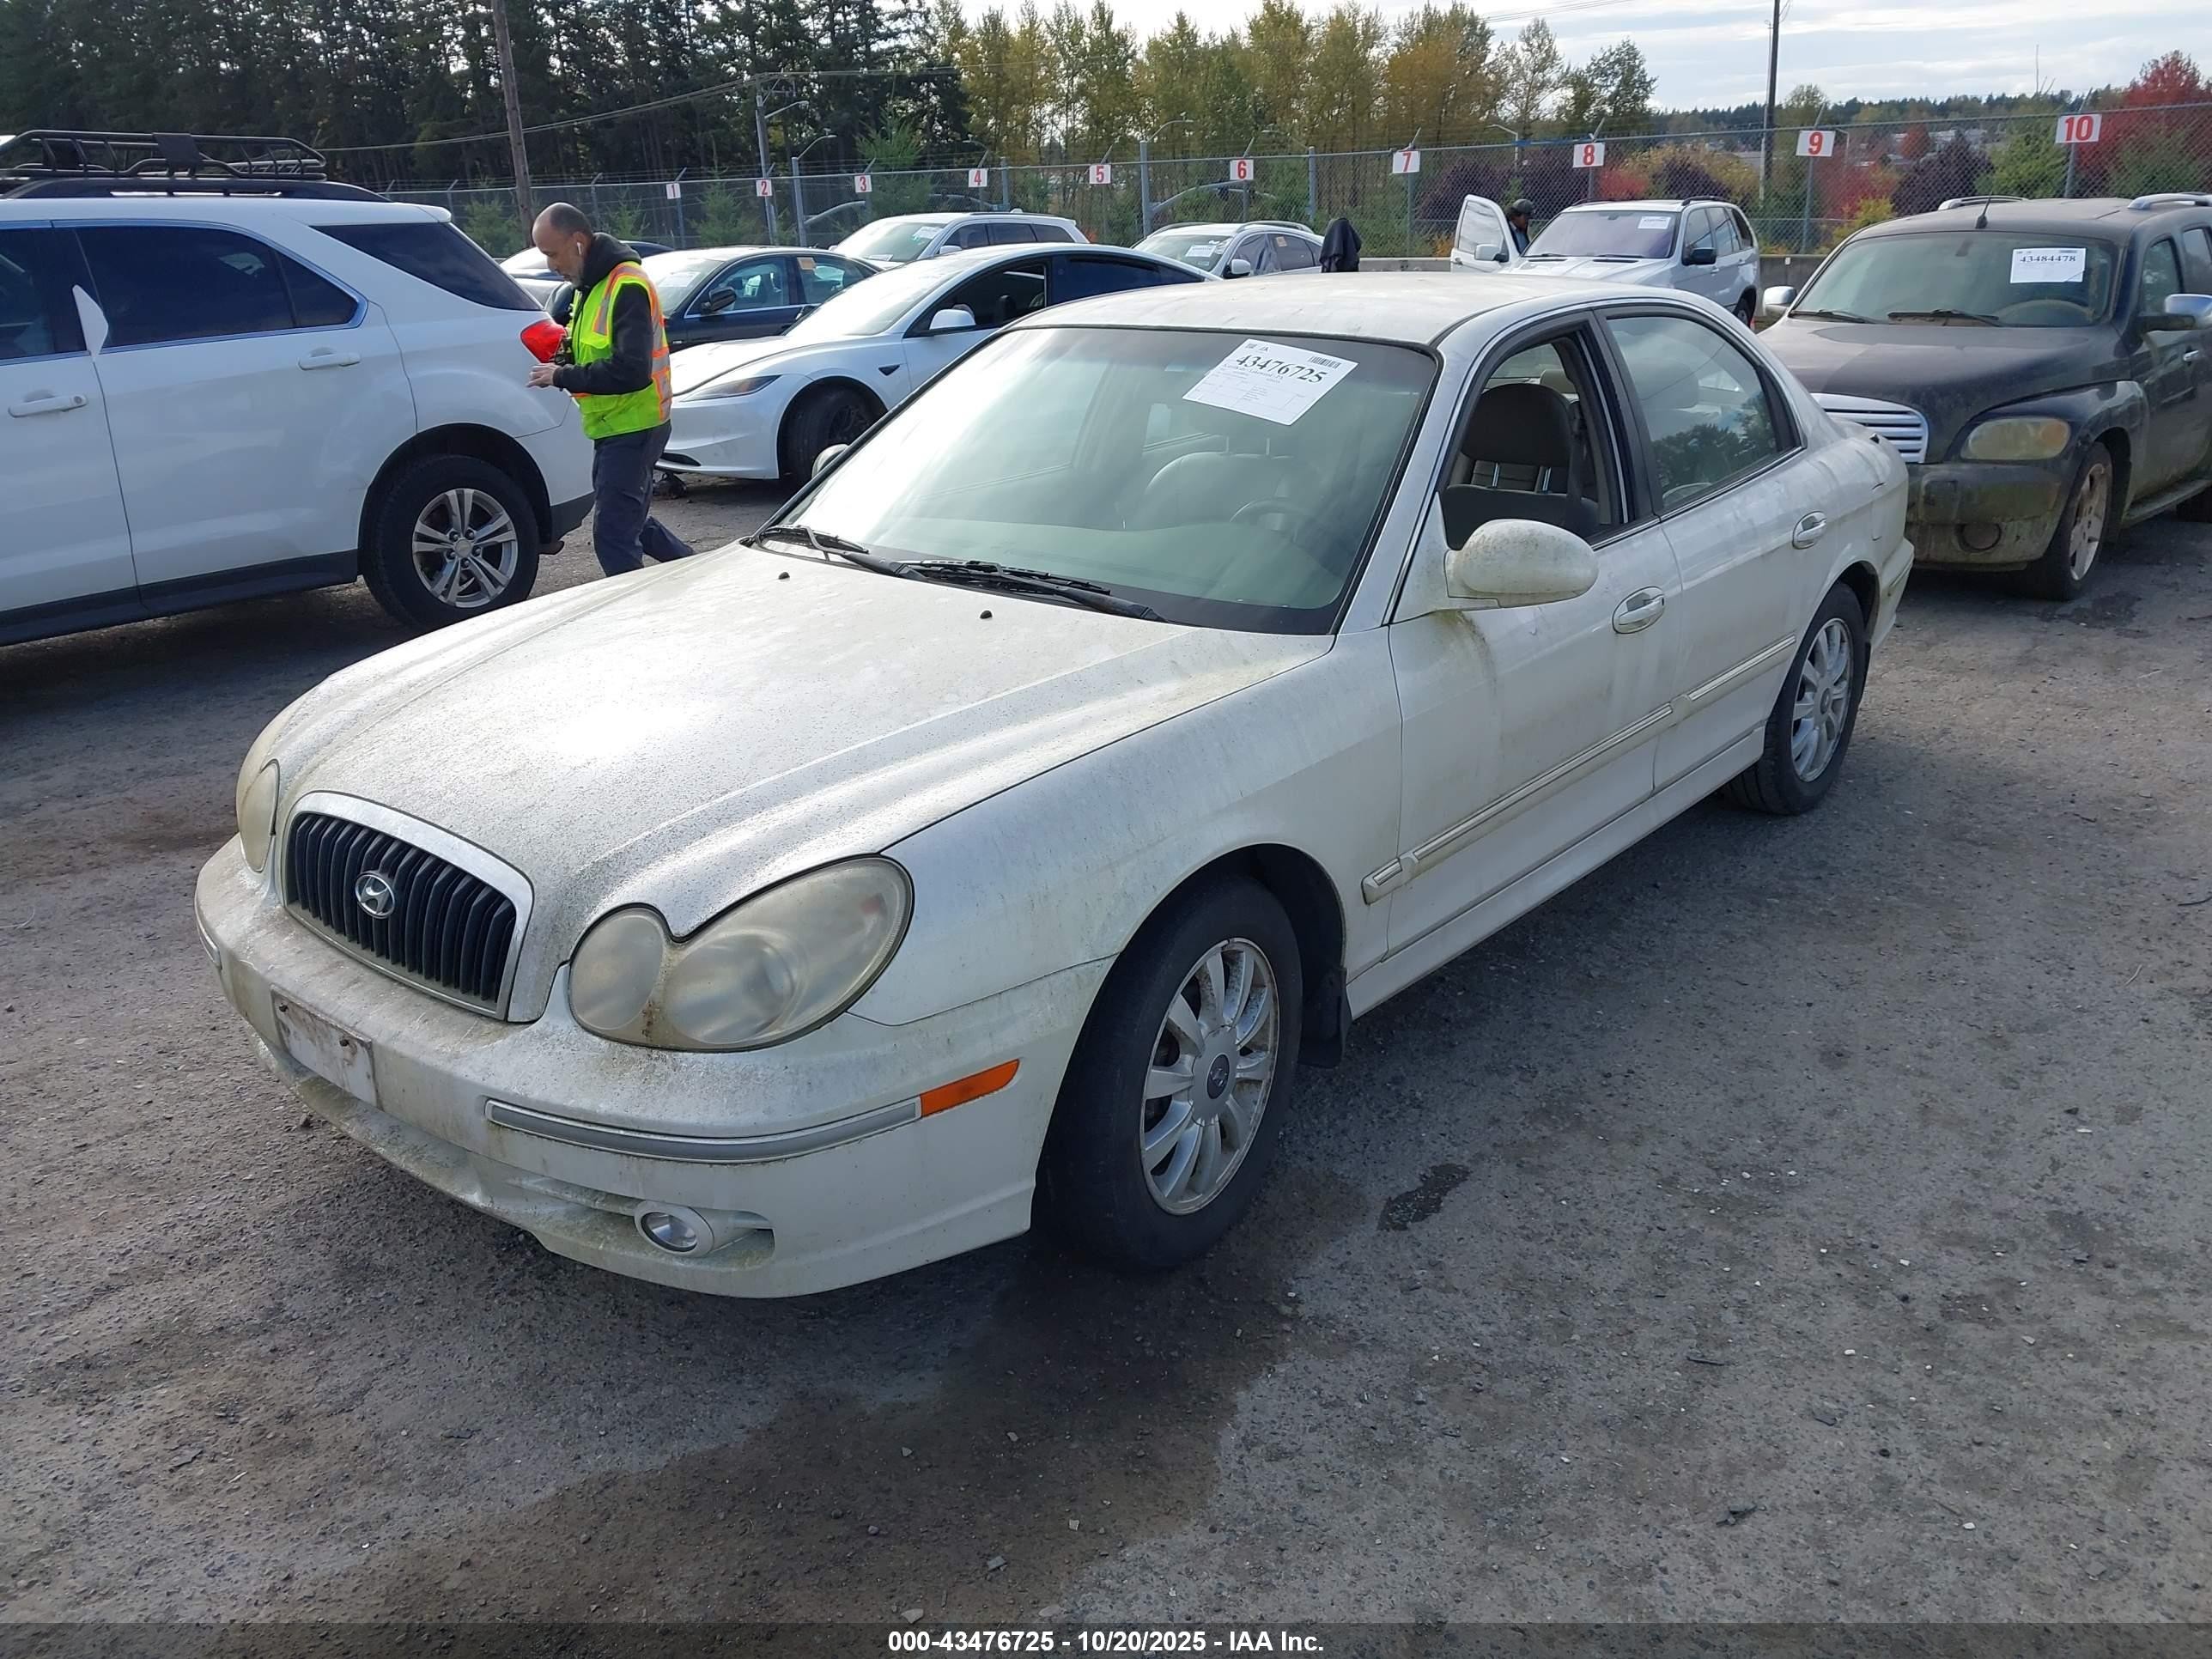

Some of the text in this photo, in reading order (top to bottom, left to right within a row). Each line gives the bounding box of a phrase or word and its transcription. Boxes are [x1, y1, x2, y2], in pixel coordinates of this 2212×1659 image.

[2065, 116, 2093, 141] 10
[1808, 132, 1823, 155] 9
[1402, 152, 1412, 172] 7
[1583, 144, 1595, 165] 8
[974, 169, 982, 185] 4
[1096, 165, 1104, 183] 5
[1237, 161, 1247, 179] 6
[671, 184, 676, 198] 1
[761, 181, 768, 195] 2
[860, 176, 866, 191] 3
[1236, 355, 1328, 383] 43476725
